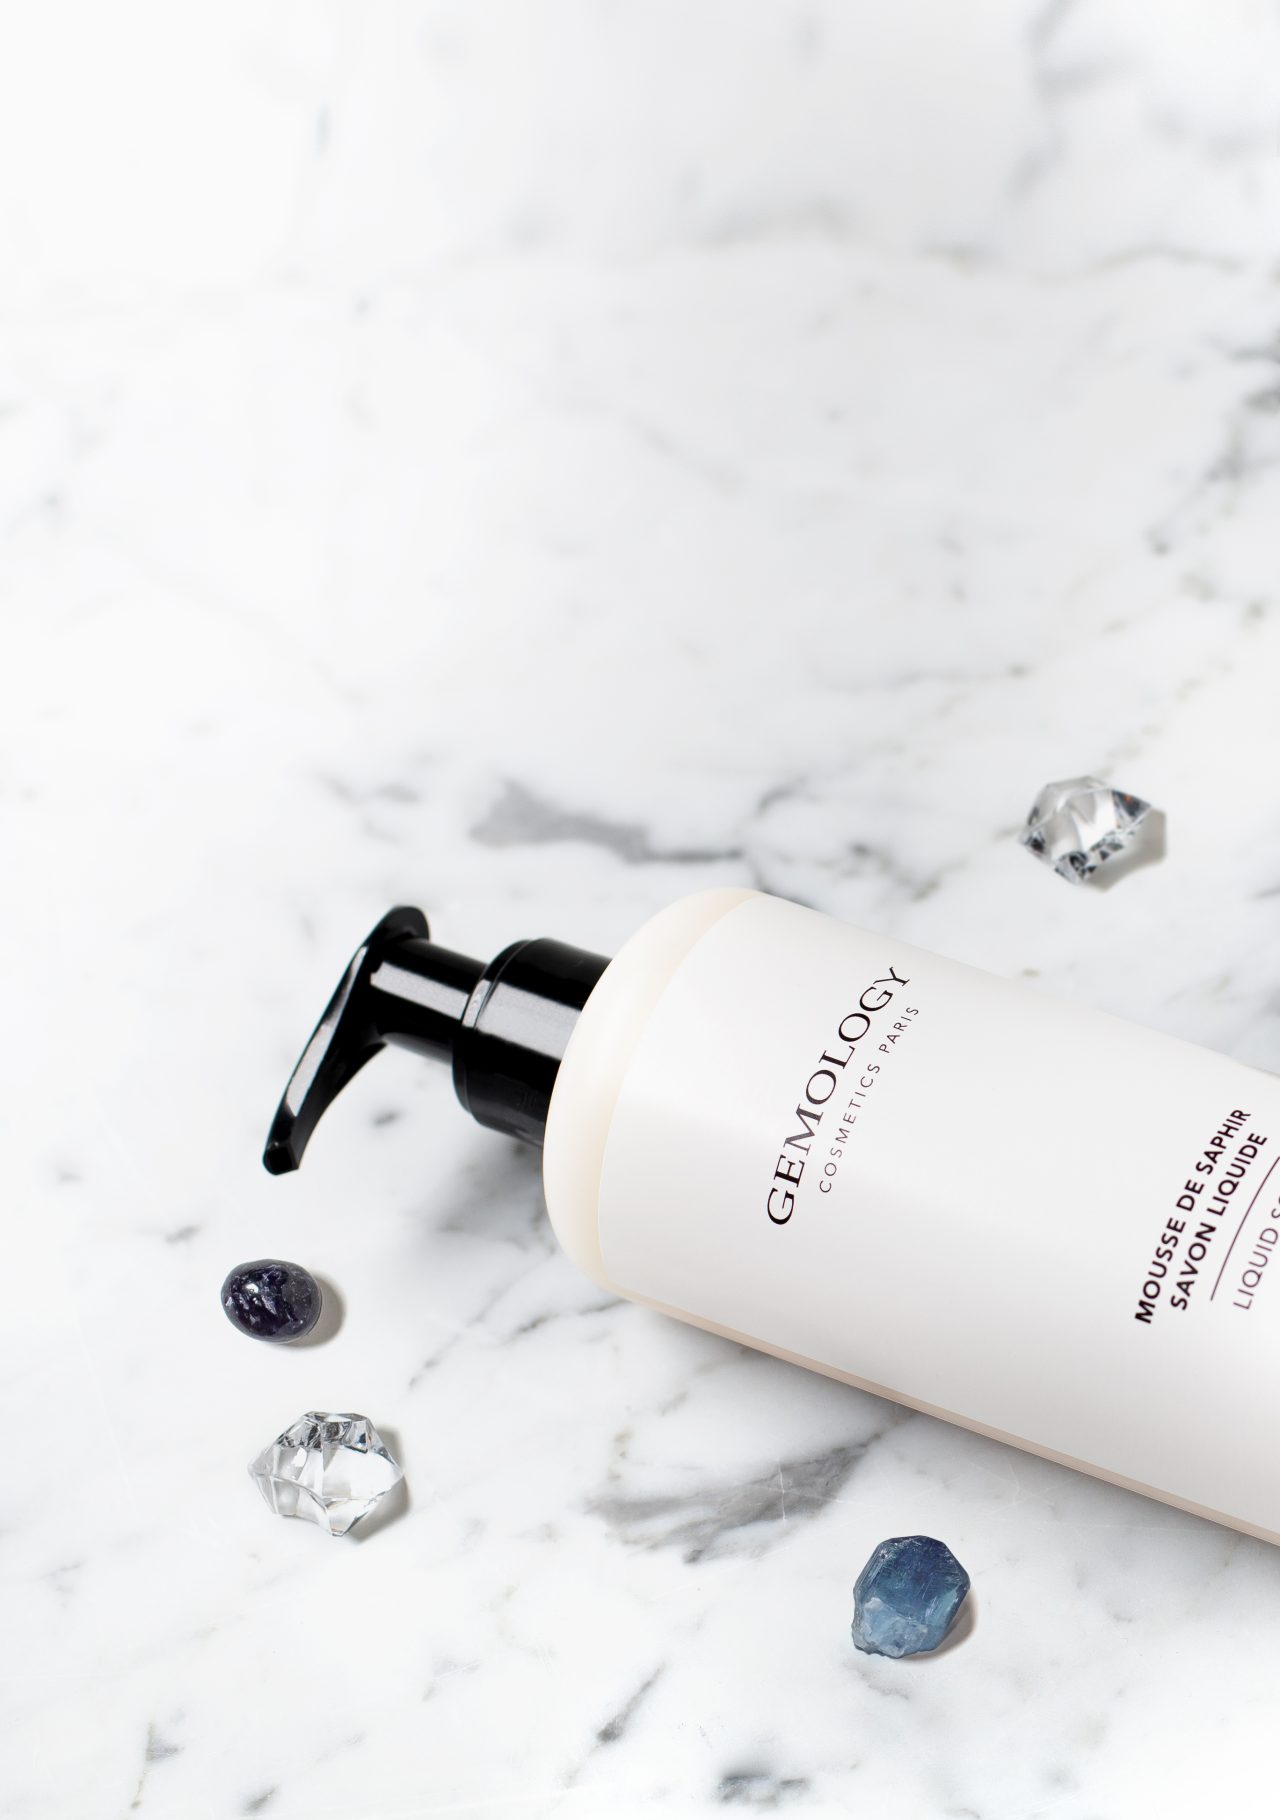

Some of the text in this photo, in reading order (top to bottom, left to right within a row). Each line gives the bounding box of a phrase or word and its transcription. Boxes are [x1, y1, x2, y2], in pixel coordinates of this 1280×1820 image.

[767, 966, 910, 1225] GEMOLOGY
[819, 1007, 919, 1193] COSMETICS PARIS
[1135, 1109, 1251, 1324] MOUSSE DE SAPHIR
[1170, 1133, 1268, 1311] SAVON LIQUIDE
[1233, 1228, 1279, 1310] LIQUID
